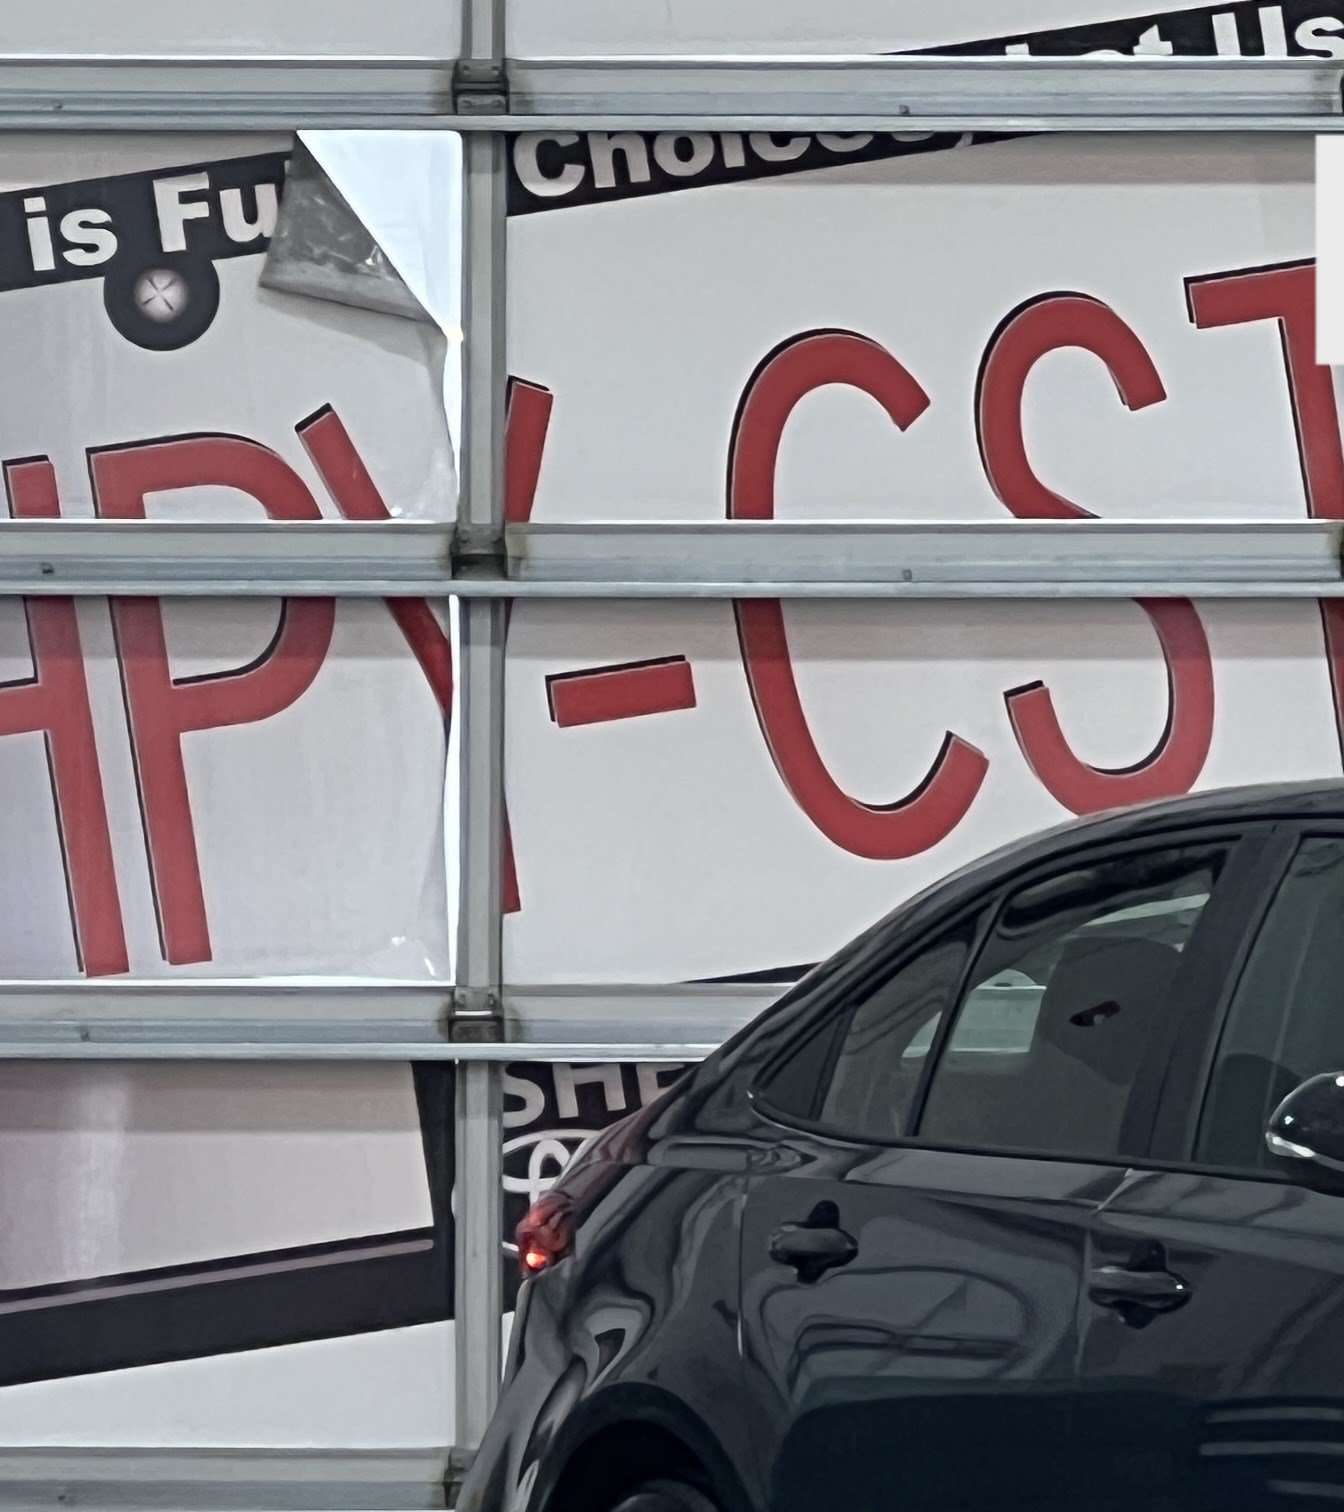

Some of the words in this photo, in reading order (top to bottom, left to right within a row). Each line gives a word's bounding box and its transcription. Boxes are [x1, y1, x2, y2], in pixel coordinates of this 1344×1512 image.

[512, 131, 975, 197] Choi,
[23, 195, 118, 272] is
[152, 159, 289, 253] Fu
